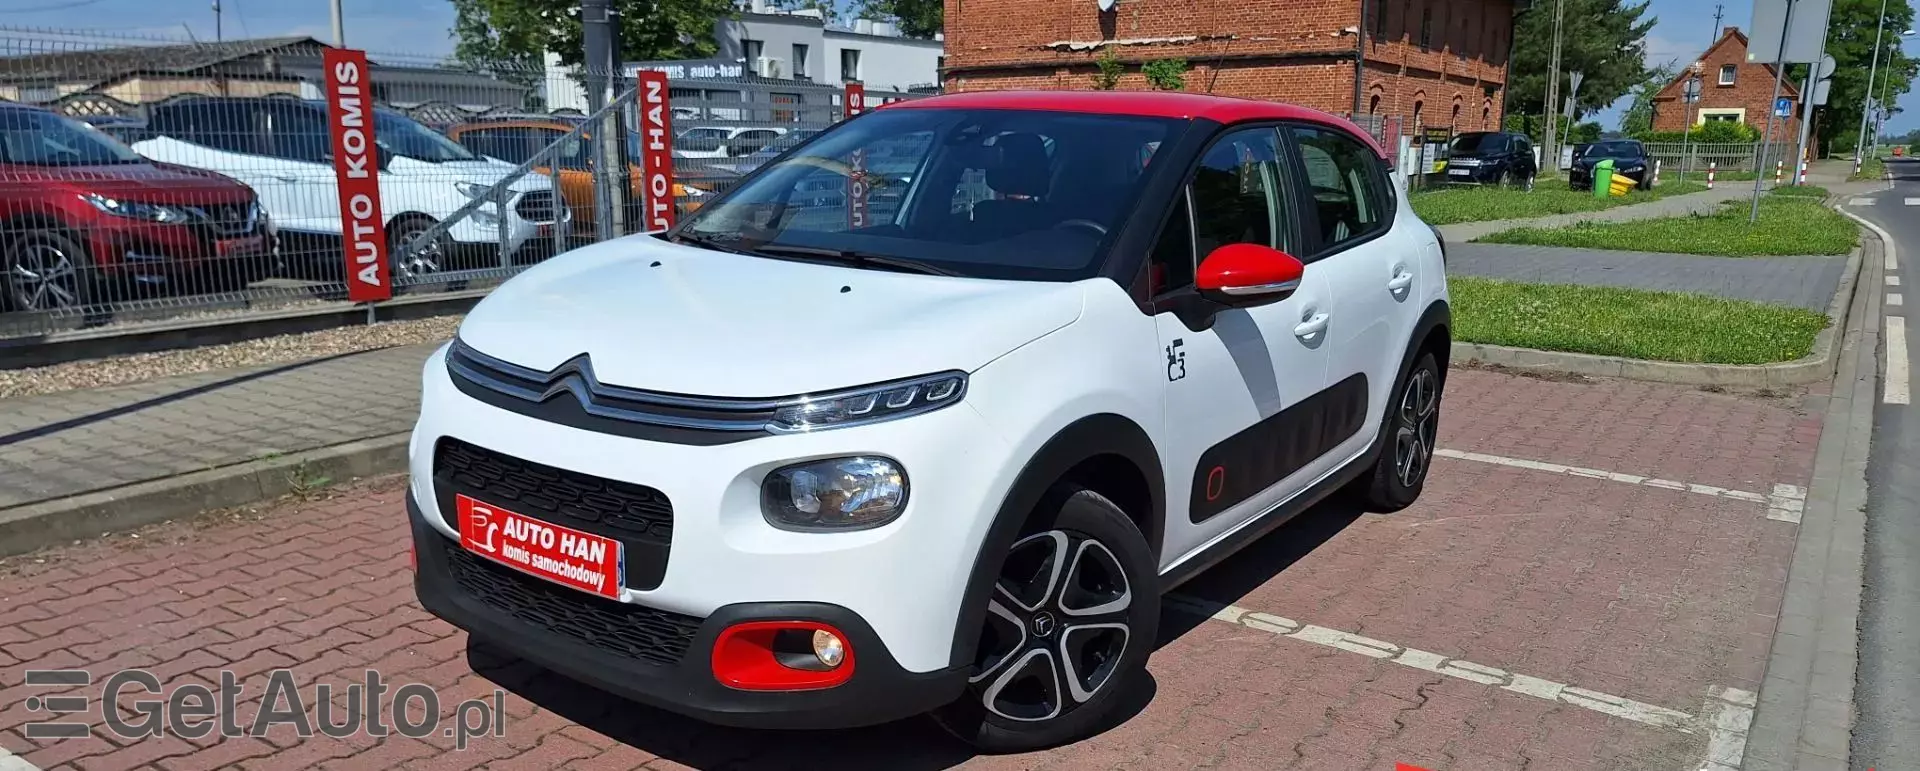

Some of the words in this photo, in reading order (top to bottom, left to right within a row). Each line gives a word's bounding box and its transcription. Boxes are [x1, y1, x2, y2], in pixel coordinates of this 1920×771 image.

[690, 64, 743, 78] auto-han
[335, 61, 369, 179] KOMIS
[646, 80, 669, 232] UTO-HAN
[852, 182, 863, 227] UTO
[350, 193, 381, 287] AUTO
[502, 539, 530, 565] komis
[532, 553, 606, 591] samochodowy
[503, 516, 555, 549] AUTO
[560, 532, 607, 565] HAN
